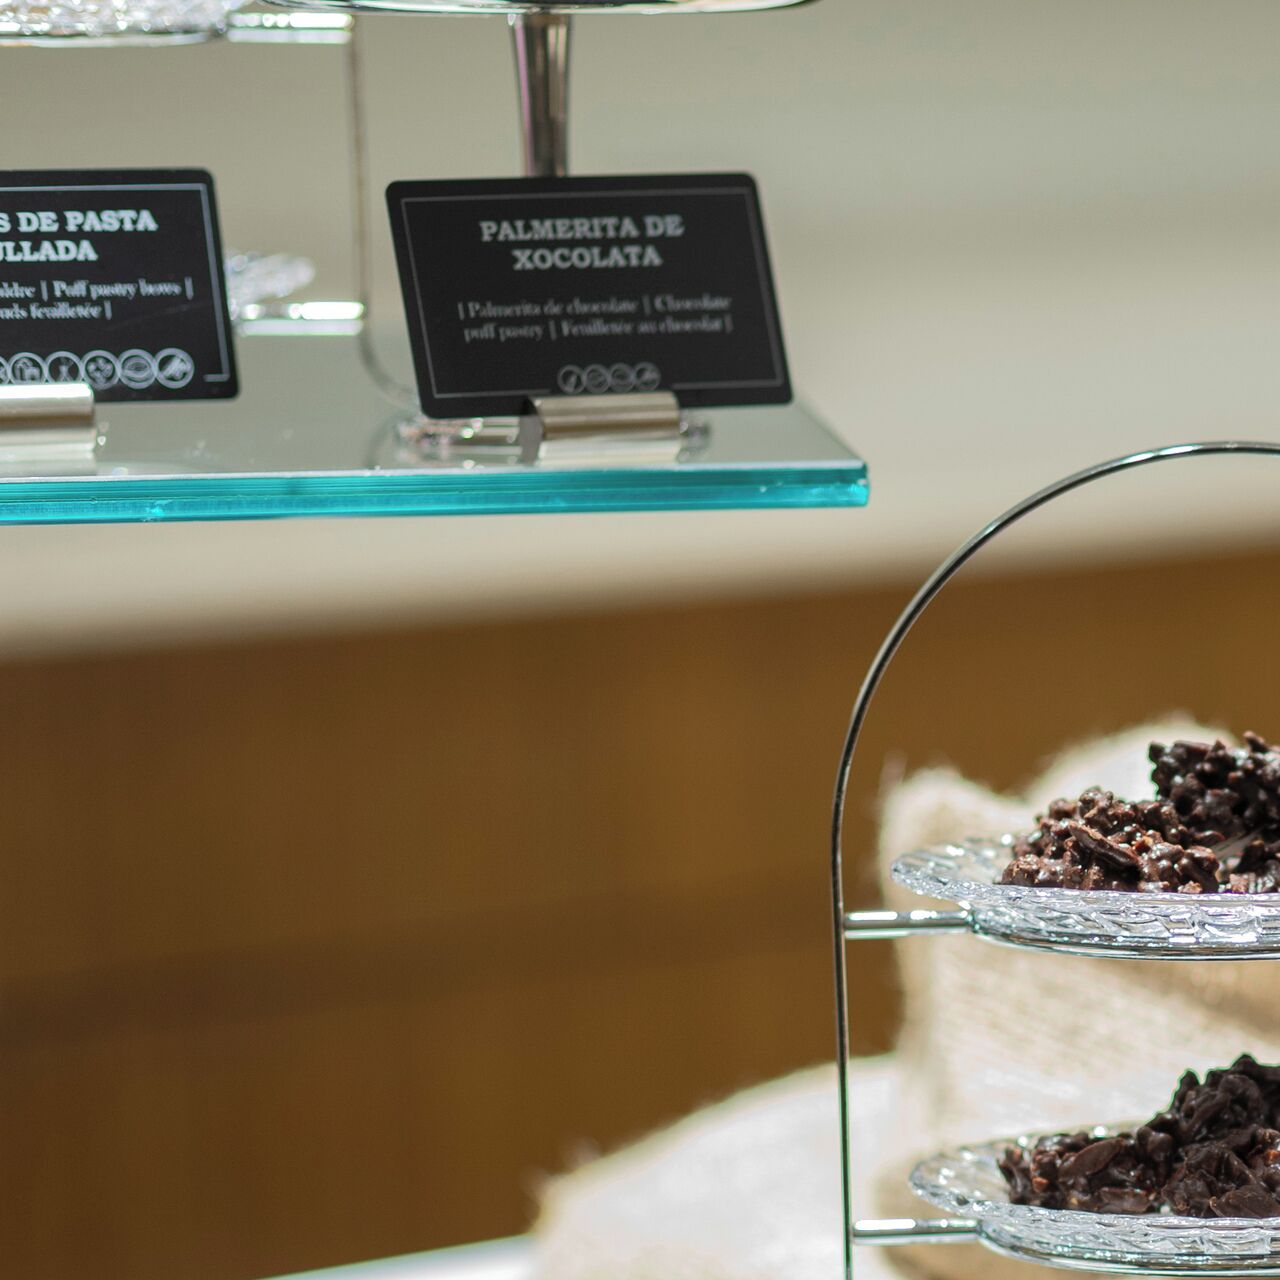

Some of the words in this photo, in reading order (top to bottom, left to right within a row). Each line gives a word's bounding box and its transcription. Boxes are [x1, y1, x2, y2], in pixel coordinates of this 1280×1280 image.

[16, 211, 60, 232] DE
[62, 208, 159, 232] PASTA
[479, 216, 641, 242] PALMERITA
[643, 213, 686, 238] DE
[0, 239, 99, 263] LLADA
[511, 244, 664, 271] XOCOLATA
[467, 300, 541, 319] Palmerita
[543, 298, 563, 316] de
[565, 295, 638, 315] chocolate
[654, 292, 732, 312] Chocolate
